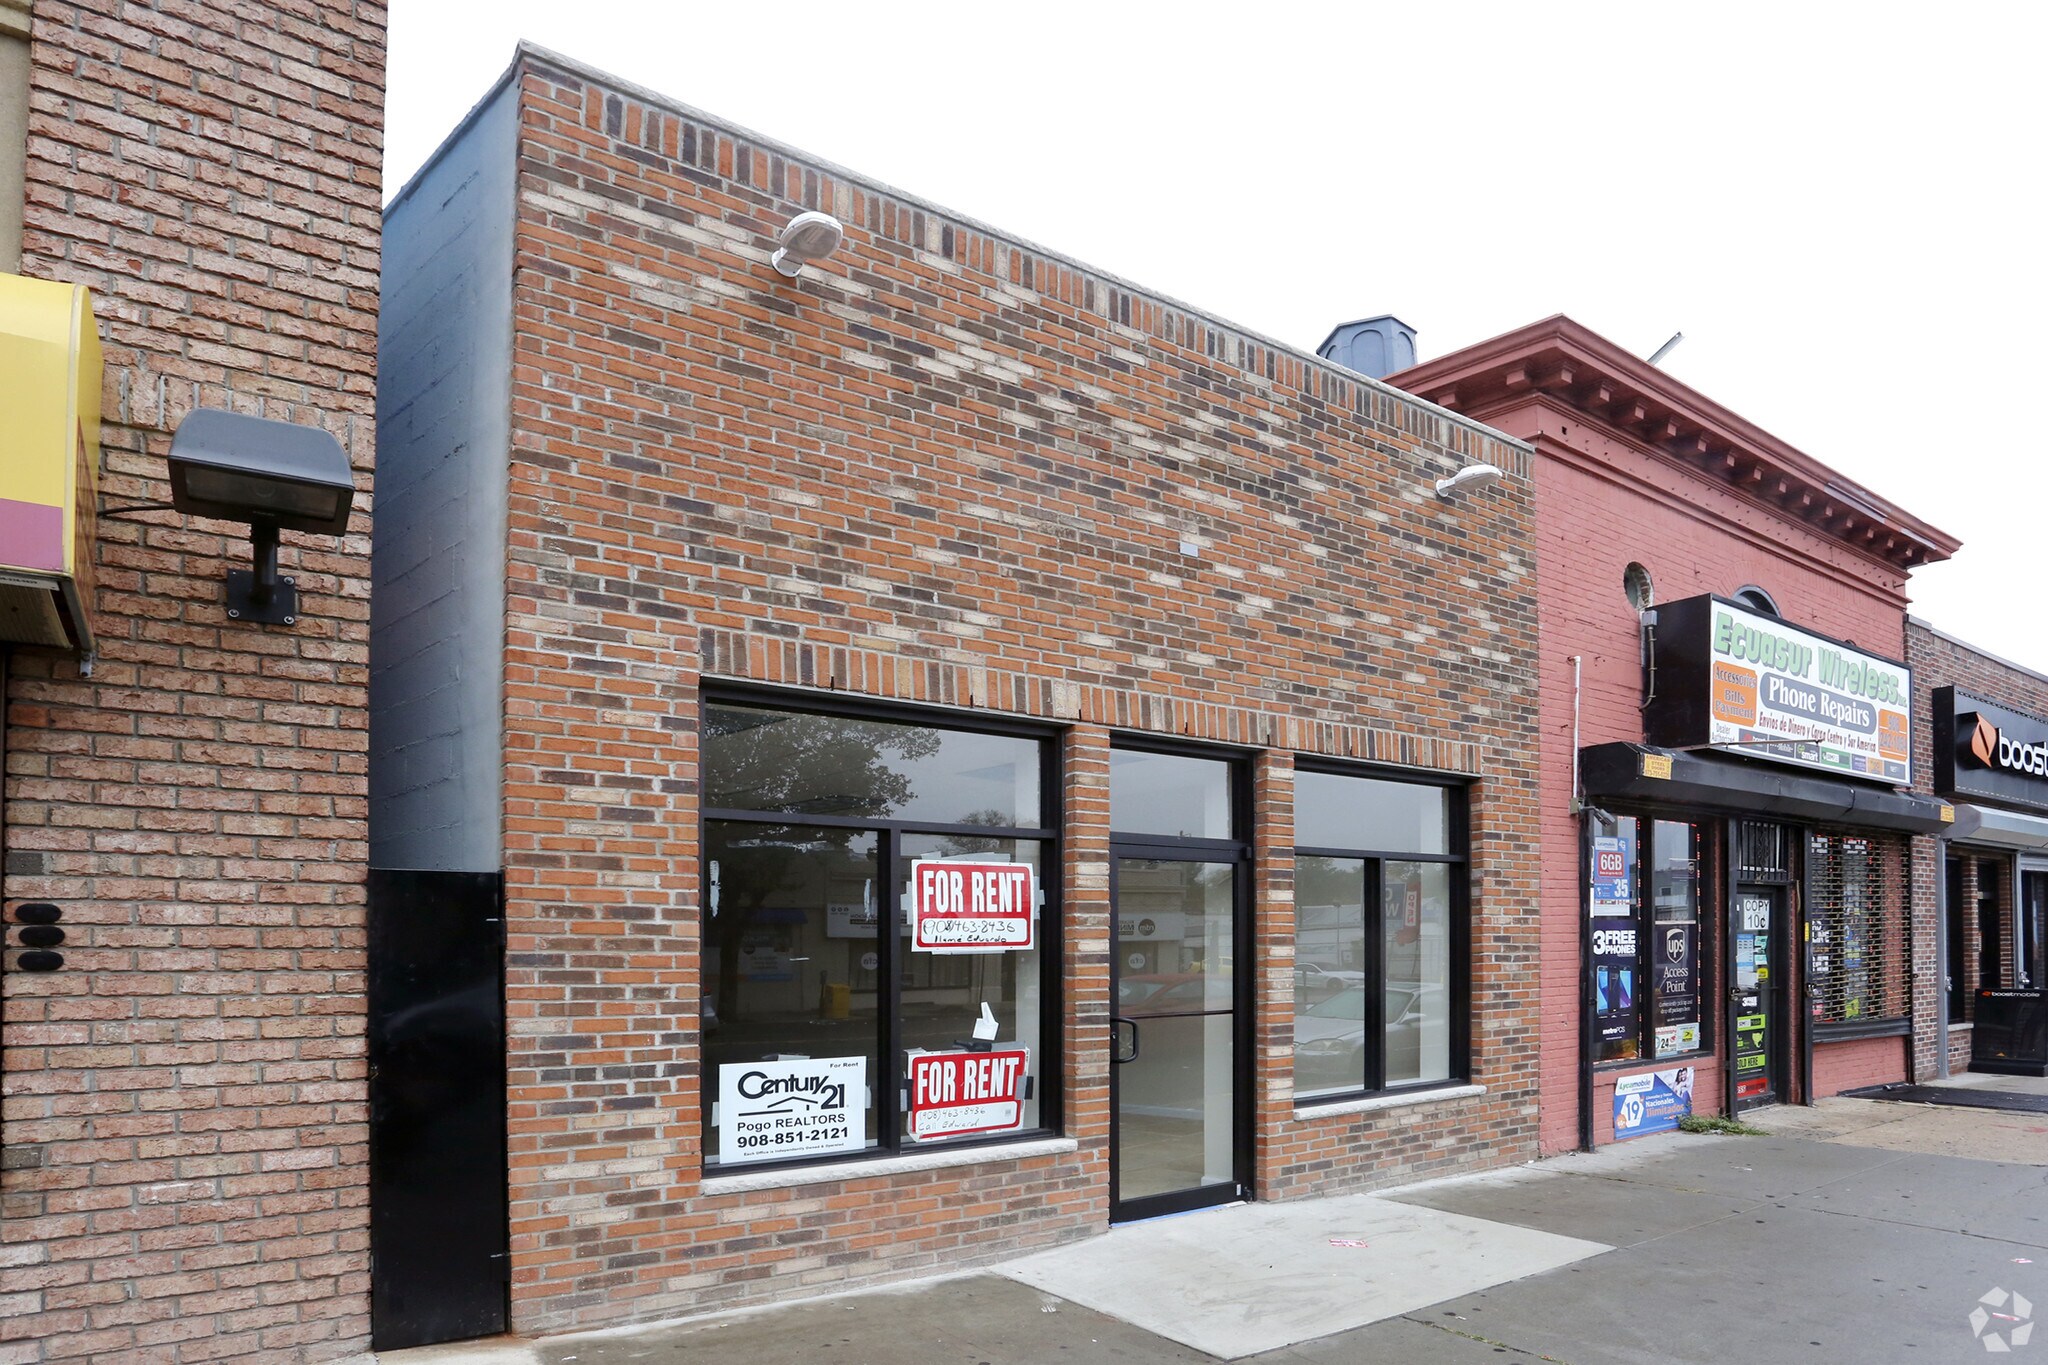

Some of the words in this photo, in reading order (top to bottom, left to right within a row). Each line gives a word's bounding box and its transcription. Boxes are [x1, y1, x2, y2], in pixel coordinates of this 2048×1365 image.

[1714, 611, 1812, 679] Ecuasur
[1817, 646, 1899, 706] Wireless
[1716, 666, 1756, 688] Accessories
[1724, 689, 1745, 704] Bills
[1768, 676, 1817, 713] Phone
[1820, 692, 1870, 727] Repairs
[1714, 700, 1753, 719] Payment
[1780, 715, 1787, 731] de
[1788, 718, 1806, 736] Dinero
[1848, 734, 1857, 749] Sur
[1857, 737, 1876, 753] America
[1801, 752, 1818, 761] smart
[1601, 854, 1622, 871] 6GB
[922, 870, 964, 913] FOR
[971, 871, 1025, 913] RENT
[1745, 900, 1769, 911] COPY
[1593, 930, 1606, 955] 3
[1605, 930, 1636, 945] FREE
[1605, 944, 1636, 955] PHONES
[1668, 939, 1684, 958] ups
[1663, 966, 1688, 978] Access
[1666, 980, 1687, 993] Point
[1602, 1026, 1626, 1035] metroPCS
[738, 1071, 829, 1099] Century
[820, 1083, 846, 1110] 21
[917, 1061, 957, 1105] FOR
[963, 1057, 1020, 1100] RENT
[1619, 1079, 1651, 1091] Lycamobile
[1626, 1101, 1640, 1121] 19
[1645, 1097, 1674, 1108] Nacionales
[737, 1121, 771, 1132] Pogo
[775, 1113, 846, 1128] REALTORS
[737, 1127, 848, 1148] 908-851-2121
